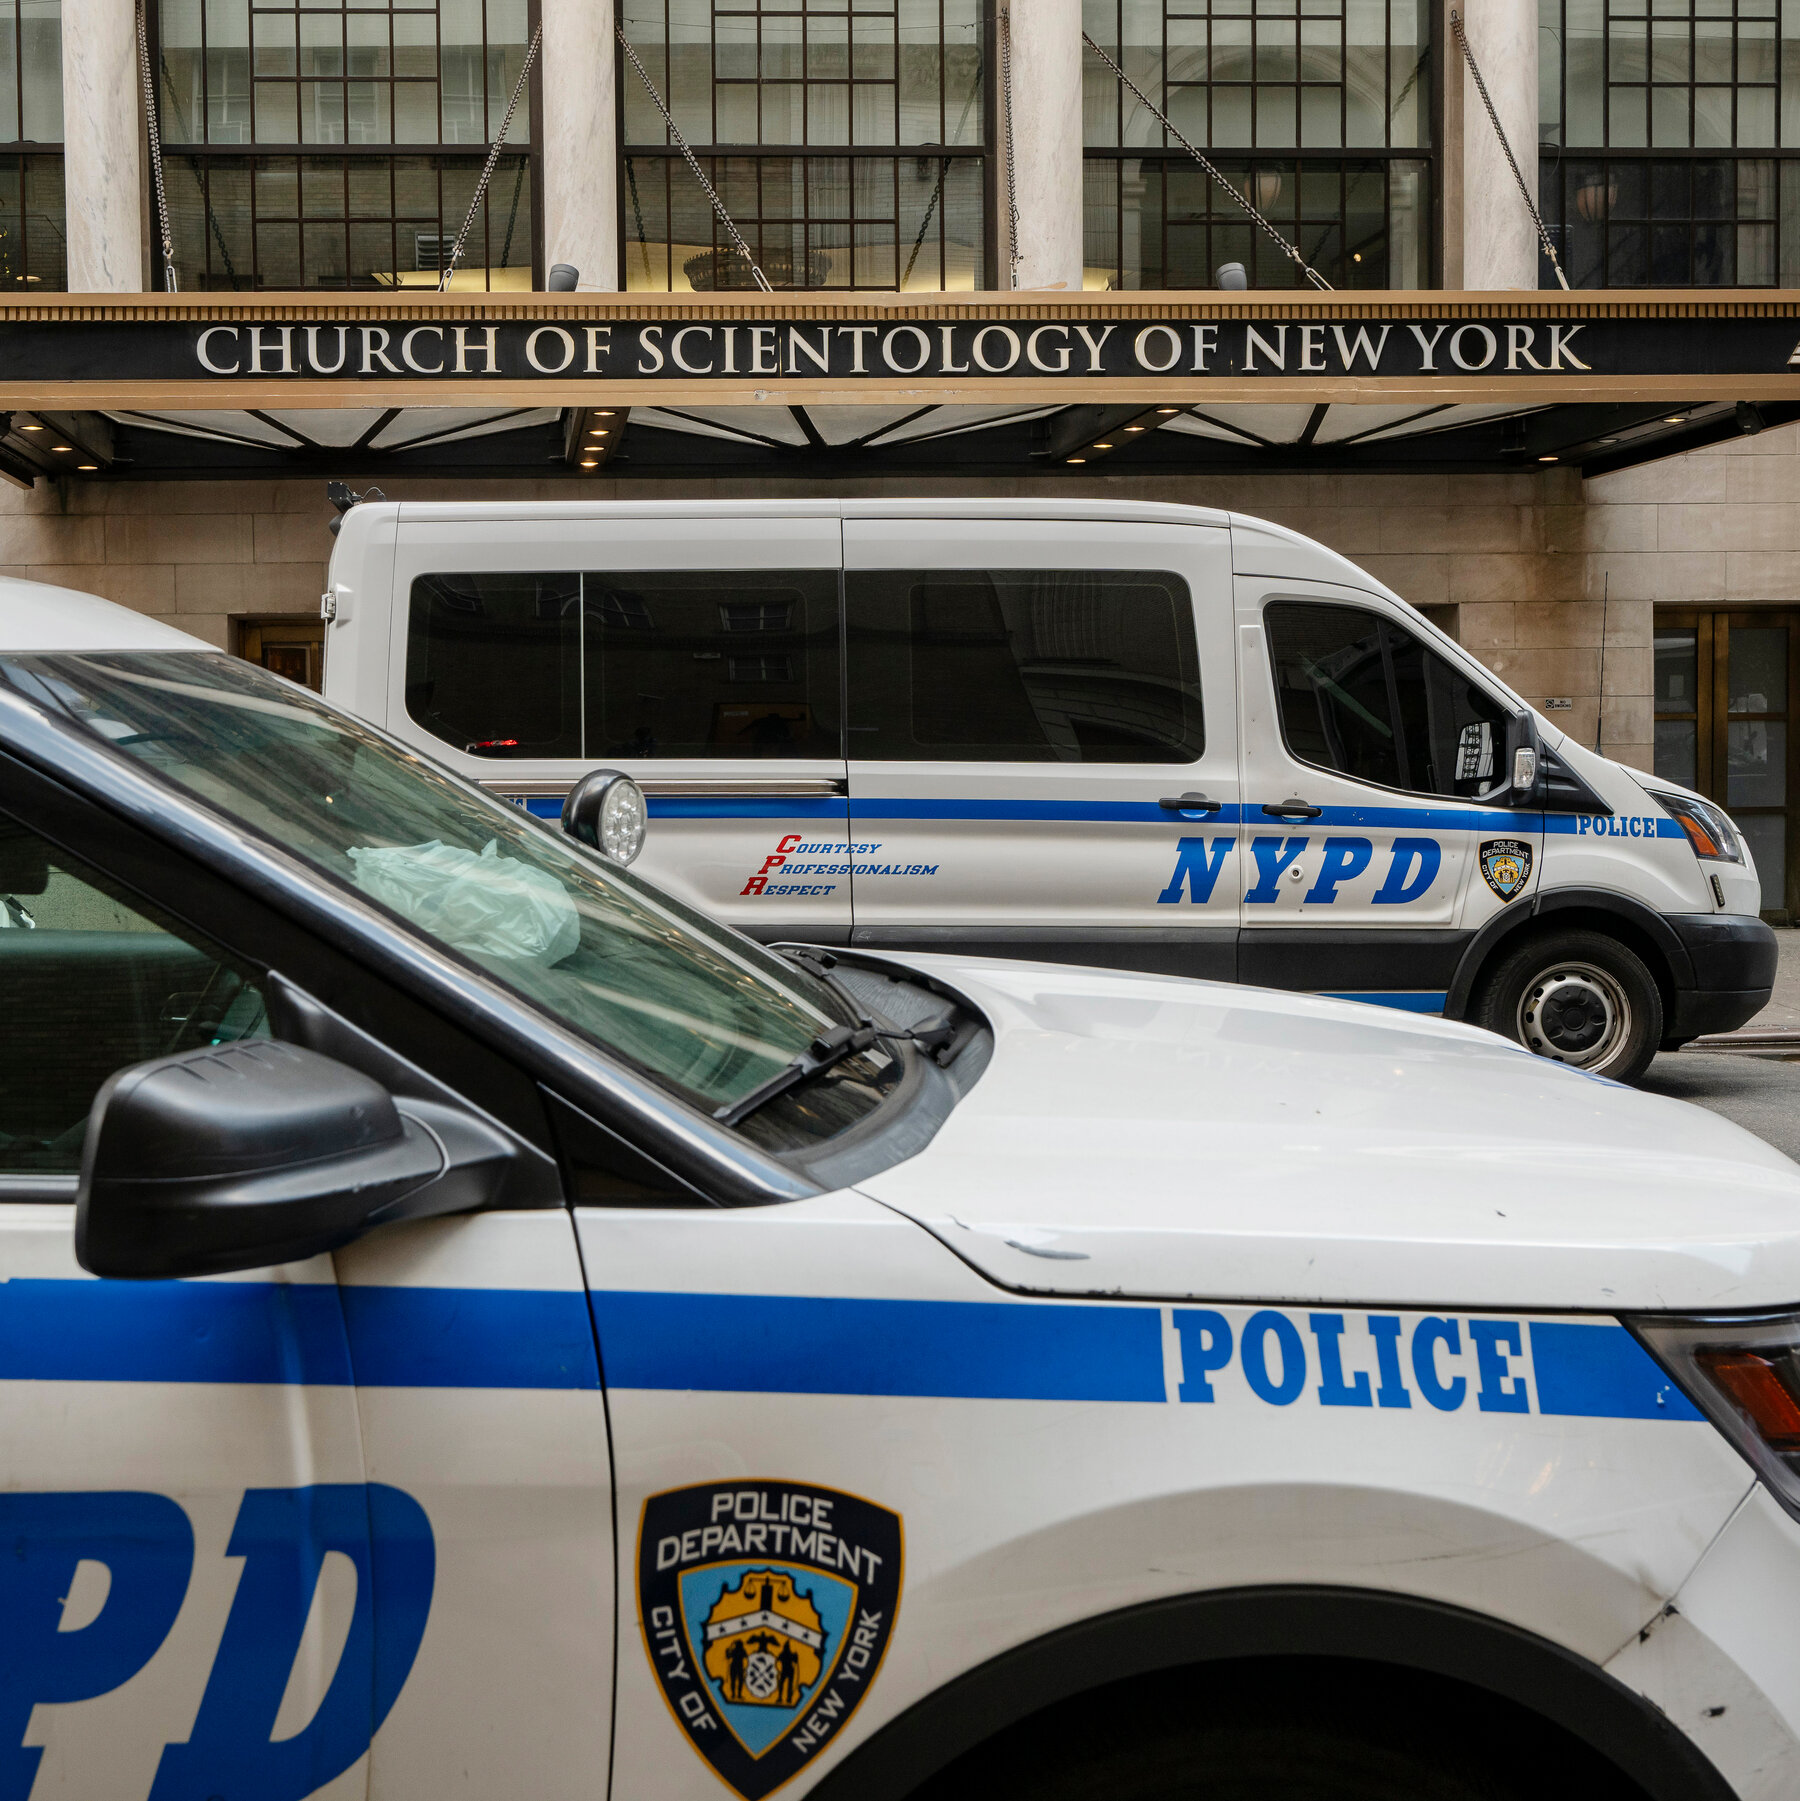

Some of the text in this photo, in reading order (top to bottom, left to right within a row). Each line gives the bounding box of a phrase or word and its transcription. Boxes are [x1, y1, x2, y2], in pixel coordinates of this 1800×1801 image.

[196, 324, 1592, 375] CHURCH OF SCIENTOLOGY OF NEW YORK
[1578, 814, 1655, 838] POLICE
[776, 835, 883, 854] COURTESY
[1482, 847, 1529, 859] DEPARTMENT
[1493, 841, 1519, 849] POLICE
[757, 855, 940, 875] PROFESSIONALISM
[1157, 837, 1442, 904] NYPD
[1482, 864, 1498, 890] CITY OF
[1513, 863, 1531, 893] NEW YORK
[739, 876, 836, 896] RESPECT
[1172, 1309, 1530, 1414] POLICE
[711, 1491, 834, 1531] POLICE
[656, 1523, 883, 1585] DEPARTMENT
[651, 1605, 717, 1731] CITY OF
[792, 1608, 883, 1753] NEW YORK
